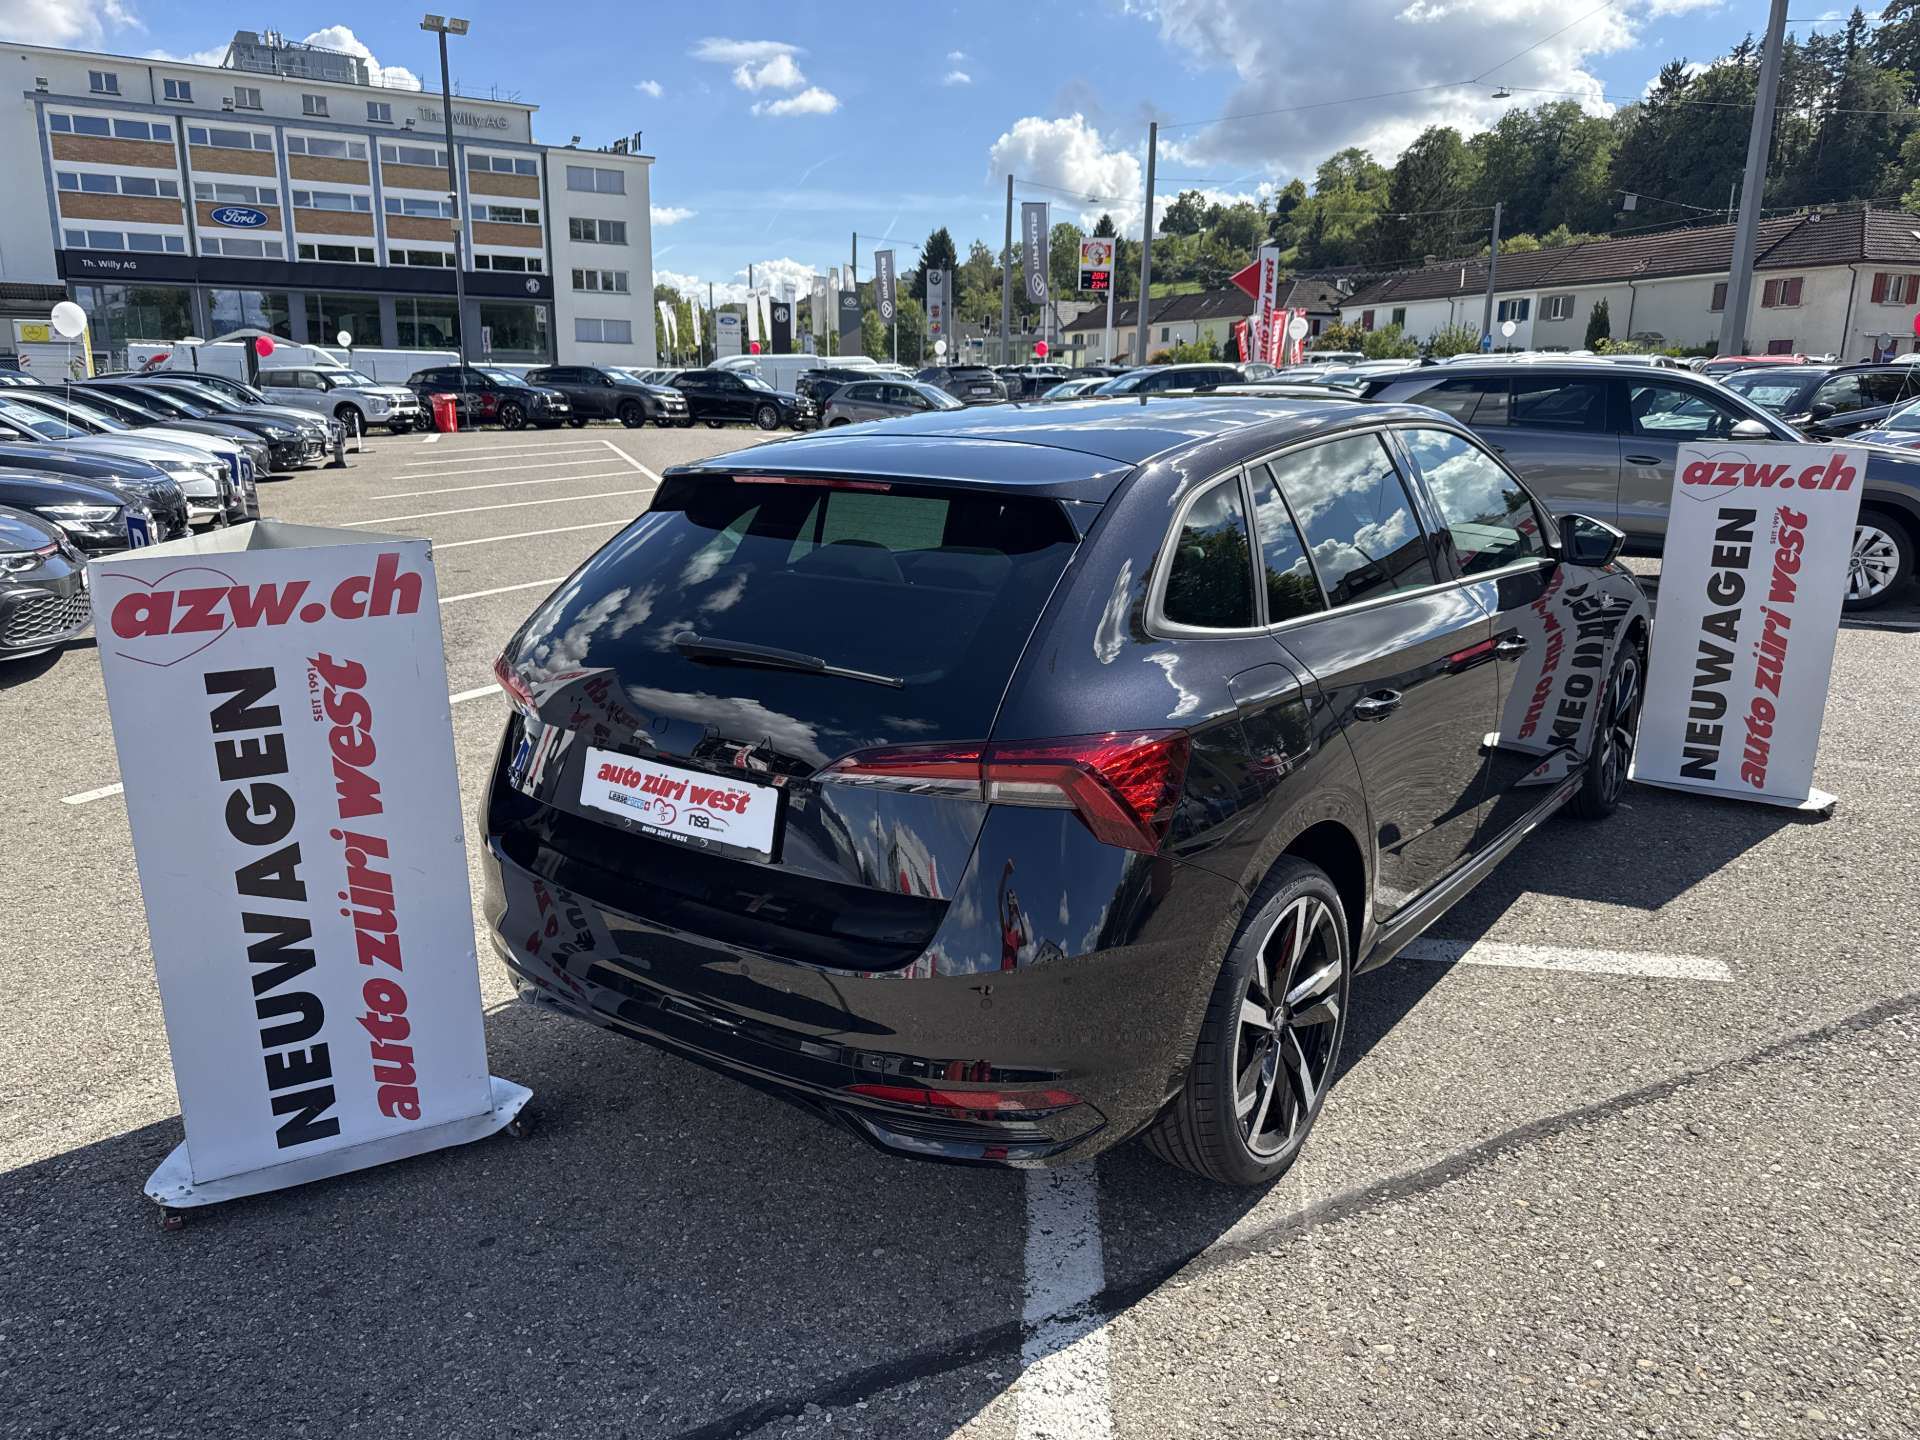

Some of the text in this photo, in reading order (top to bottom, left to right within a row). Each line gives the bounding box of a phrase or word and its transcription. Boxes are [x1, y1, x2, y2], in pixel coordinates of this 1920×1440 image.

[486, 114, 510, 129] AG
[81, 259, 137, 270] Th. Willy AG
[1265, 258, 1275, 294] west
[1682, 454, 1857, 491] azw.ch
[111, 552, 423, 639] azw.ch
[1680, 507, 1757, 781] NEUWAGEN
[1740, 505, 1808, 789] auto züri west
[307, 667, 323, 722] SEIT 1991
[597, 762, 752, 815] auto züri west
[688, 814, 710, 830] nsa
[204, 666, 341, 1150] NEUWAGEN
[306, 651, 422, 1121] auto züri west
